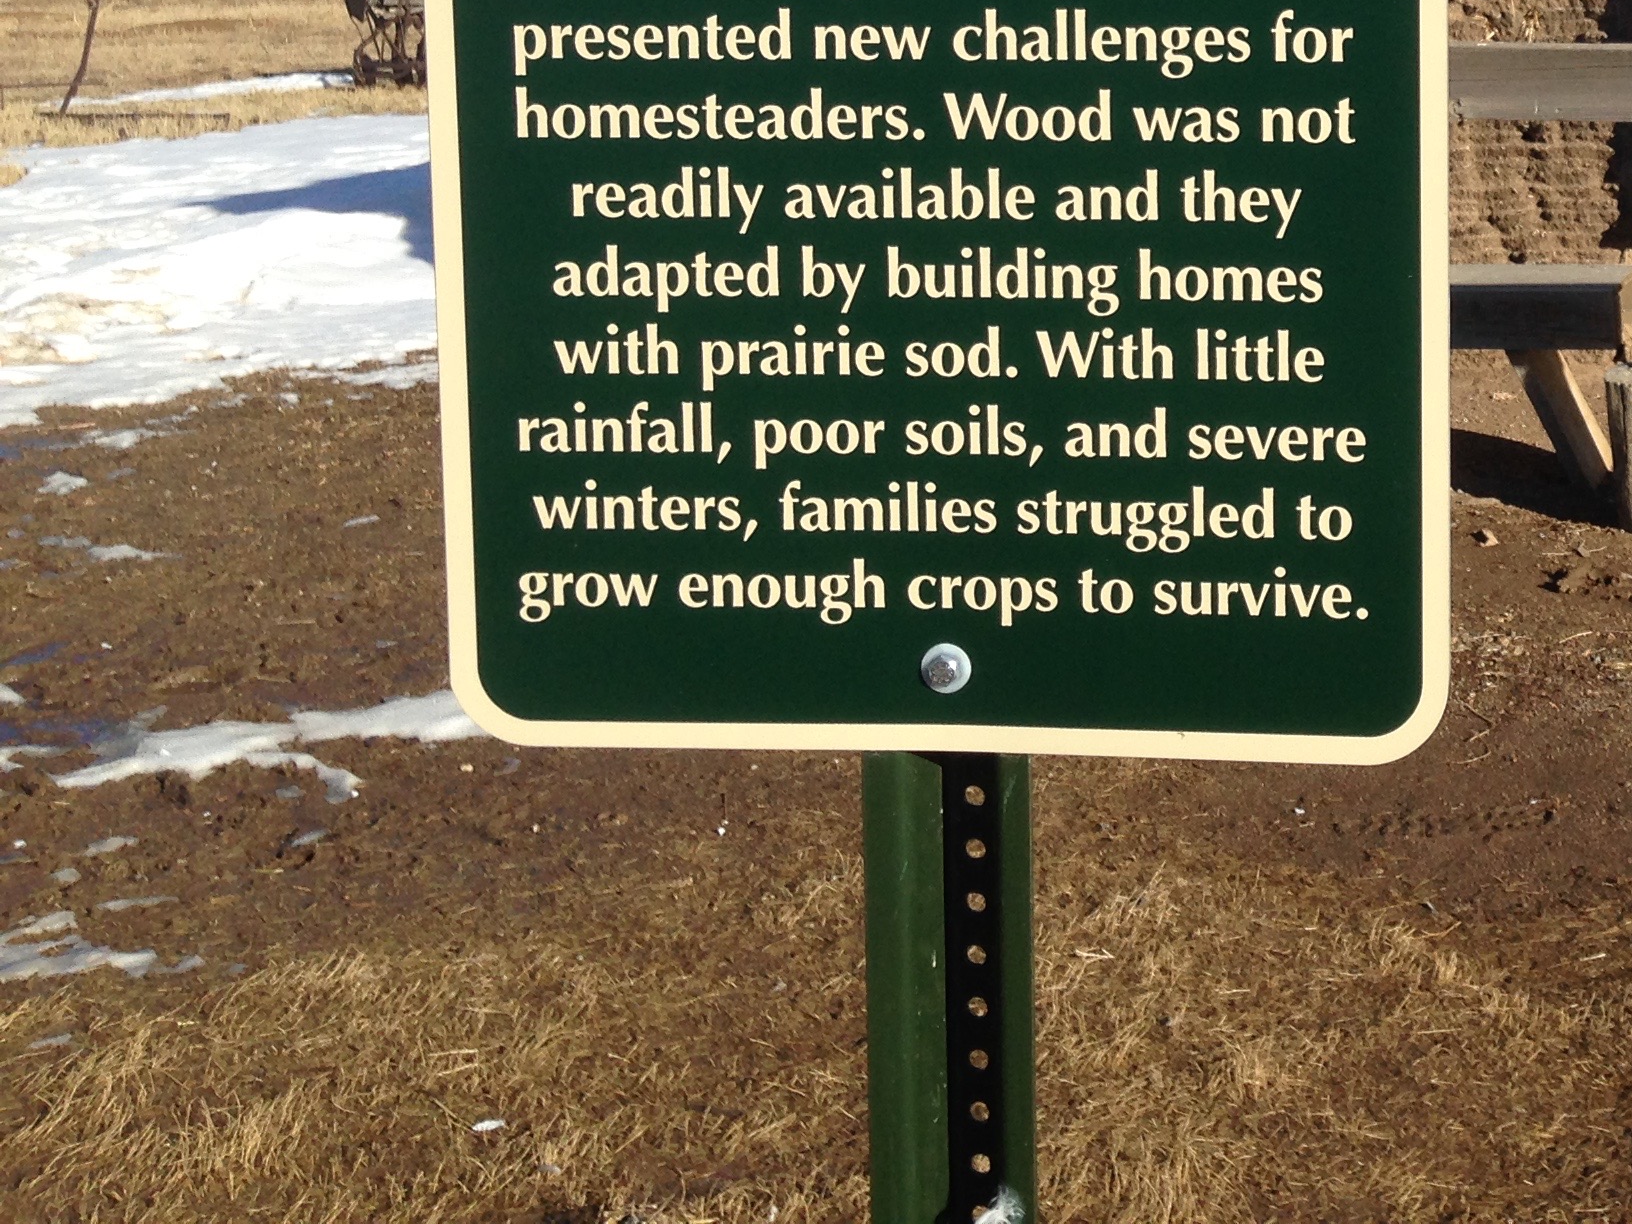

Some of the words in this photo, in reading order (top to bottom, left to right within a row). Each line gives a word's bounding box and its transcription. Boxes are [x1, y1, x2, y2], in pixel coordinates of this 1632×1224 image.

[513, 7, 792, 76] presented
[814, 24, 932, 61] new
[952, 8, 1251, 79] challenges
[1270, 9, 1354, 64] for
[515, 86, 926, 141] homesteaders.
[942, 88, 1112, 142] Wood
[1132, 106, 1240, 143] was
[1261, 97, 1356, 144] not
[571, 165, 765, 235] readily
[784, 167, 1036, 221] available
[1055, 168, 1159, 222] and
[1179, 169, 1303, 239] they
[552, 244, 780, 313] adapted
[801, 245, 866, 314] by
[887, 245, 1120, 317] building
[1138, 247, 1323, 304] homes
[553, 322, 679, 376] with
[701, 324, 886, 392] prairie
[905, 325, 1018, 379] sod.
[1035, 327, 1174, 380] With
[1196, 327, 1325, 383] little
[518, 400, 732, 465] rainfall,
[754, 418, 886, 470] poor
[905, 404, 1044, 468] soils,
[1064, 406, 1167, 459] and
[1188, 424, 1367, 463] severe
[532, 478, 758, 542] winters,
[778, 479, 997, 534] families
[1016, 485, 1275, 554] struggled
[1295, 494, 1353, 541] to
[518, 571, 659, 623] grow
[678, 557, 886, 625] enough
[907, 574, 1059, 627] crops
[1077, 568, 1134, 614] to
[1153, 566, 1369, 620] survive.
